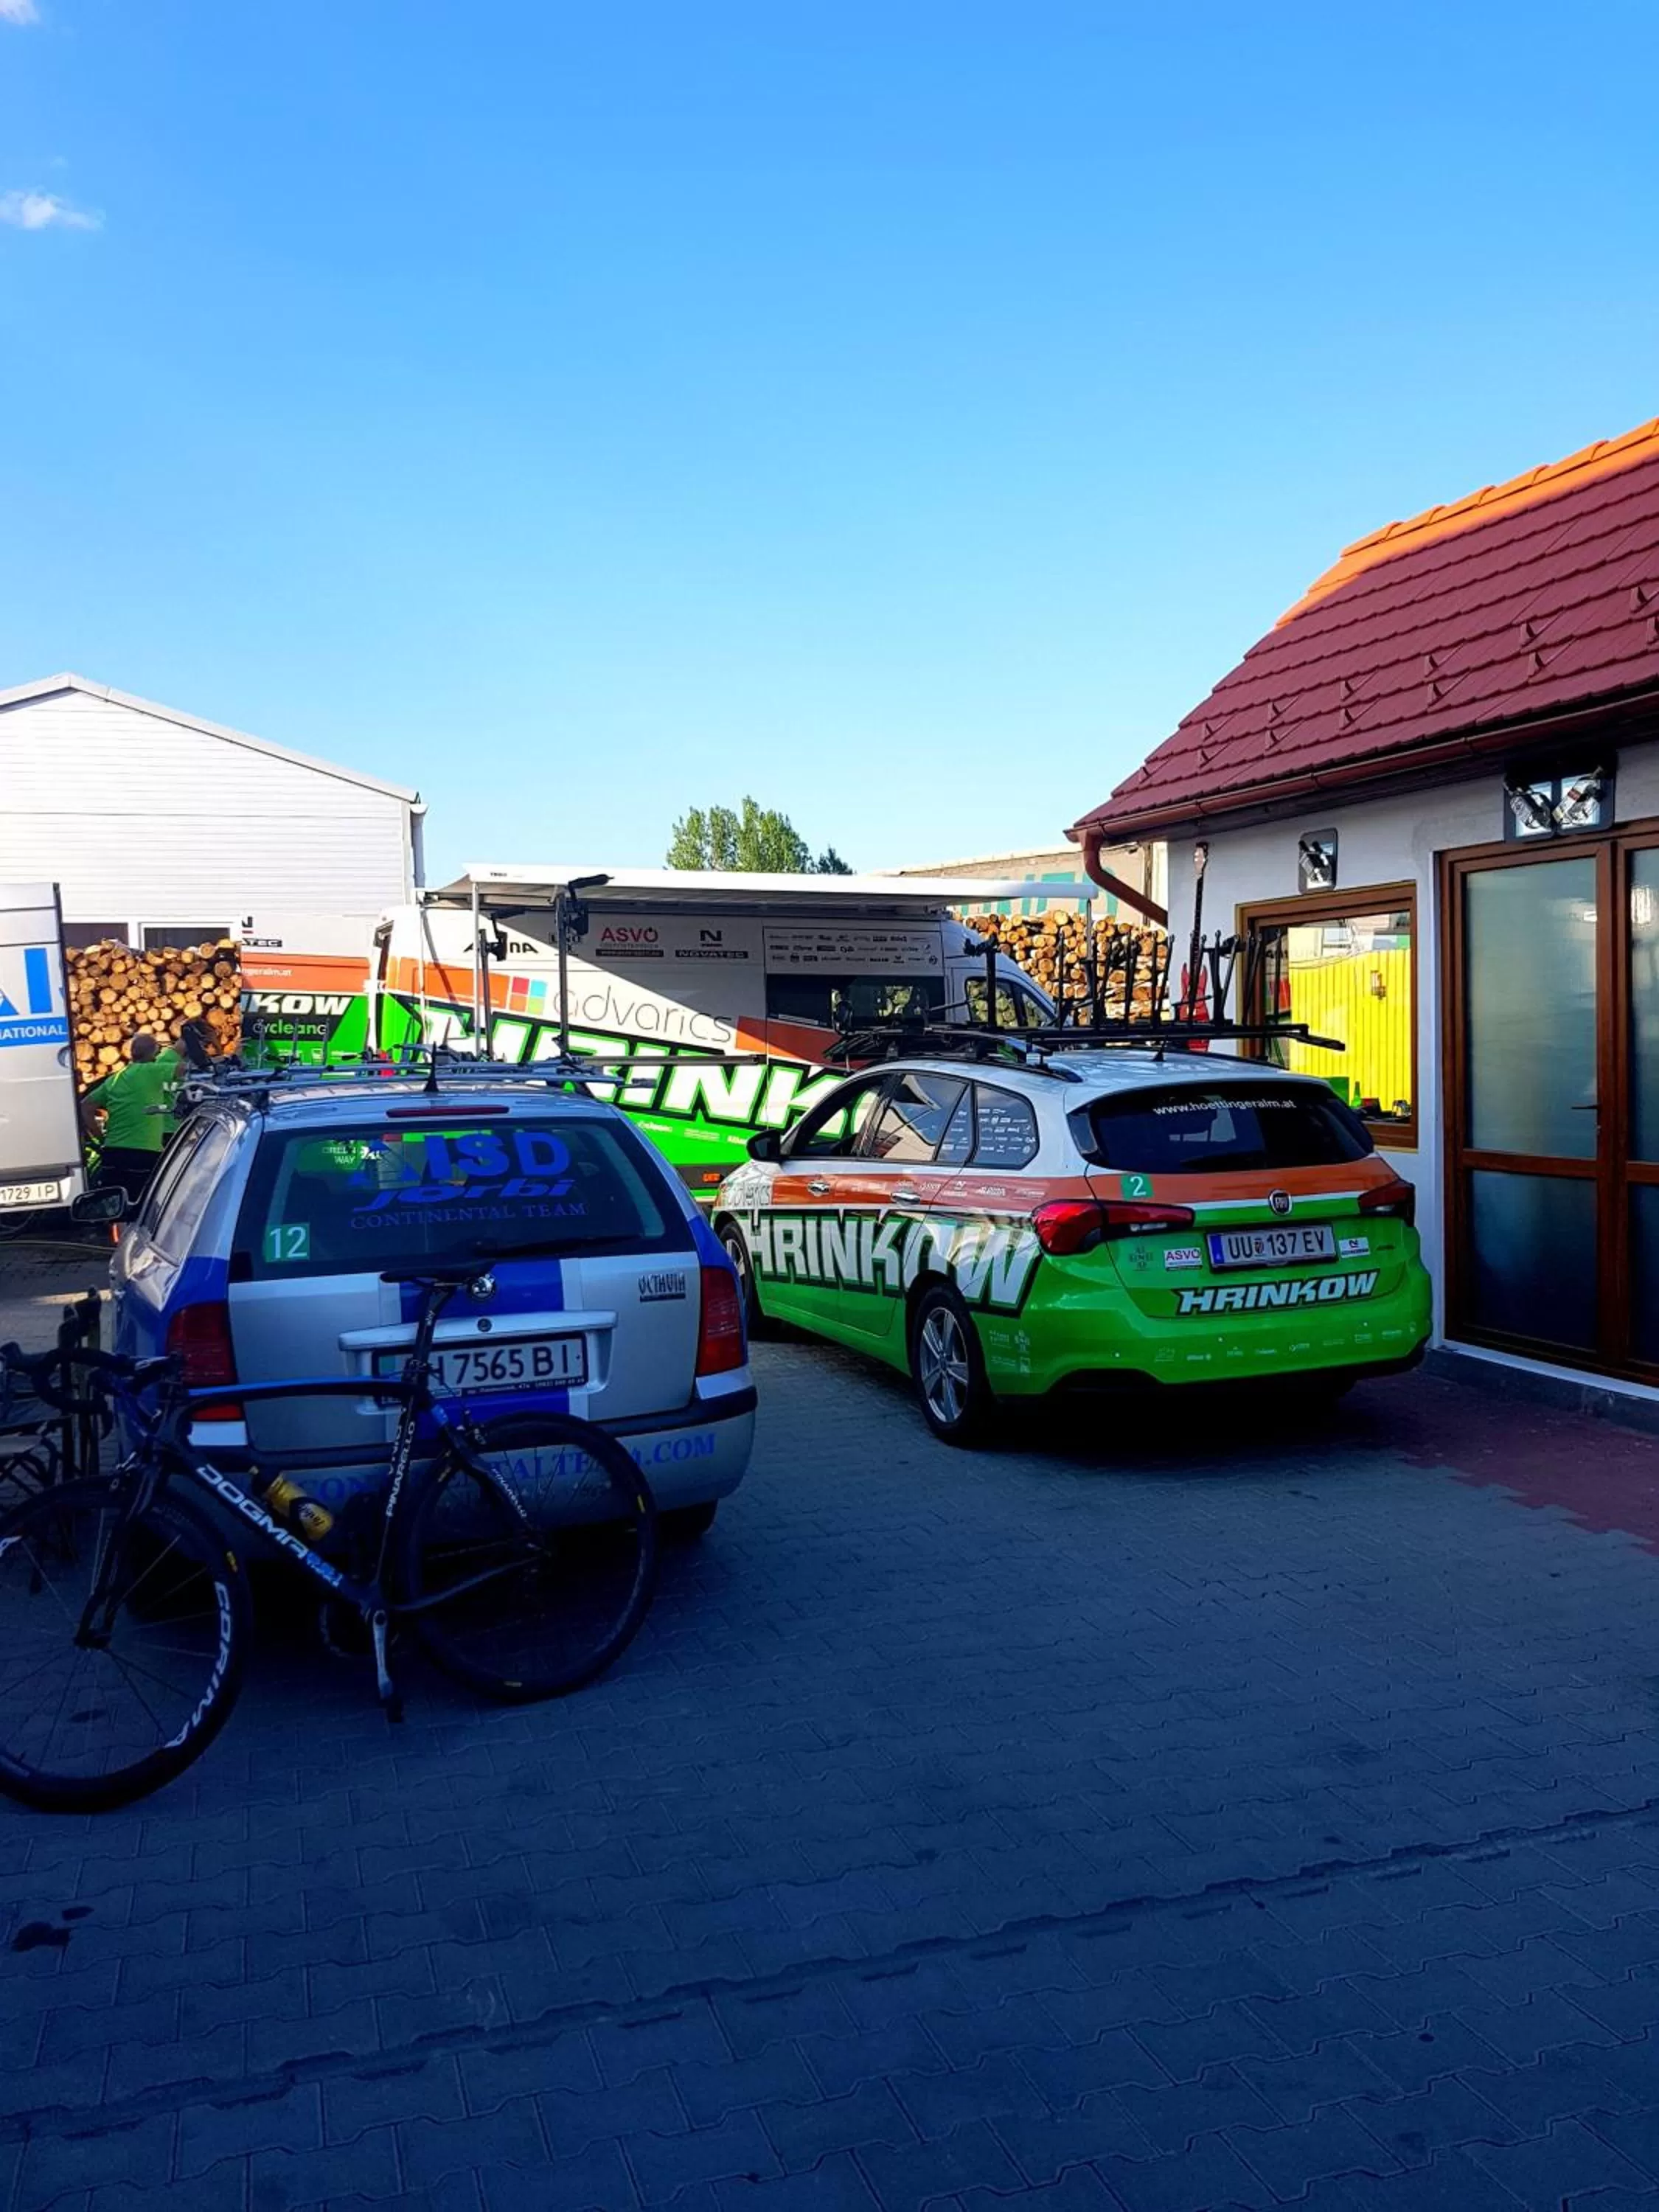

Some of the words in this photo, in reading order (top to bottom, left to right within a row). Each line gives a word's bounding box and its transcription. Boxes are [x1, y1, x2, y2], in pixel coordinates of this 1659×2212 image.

[675, 949, 748, 959] NOVATEC
[553, 985, 732, 1043] advarics
[0, 1023, 67, 1040] ATIONAL
[0, 1186, 30, 1201] 1729
[1130, 1175, 1147, 1197] 2
[350, 1203, 515, 1229] CONTINENTAL
[523, 1201, 590, 1219] TEAM
[269, 1225, 307, 1259] 12
[1228, 1236, 1253, 1260] UU
[1267, 1233, 1297, 1256] 137
[1302, 1230, 1324, 1253] EV
[742, 1214, 1041, 1307] HRINKOW
[637, 1273, 686, 1295] OCTAVIA
[1178, 1270, 1379, 1314] HRINKOW
[453, 1349, 524, 1385] 7565
[532, 1344, 568, 1377] BI
[195, 1463, 310, 1560] DOGMA
[162, 1580, 232, 1748] CORIMA
